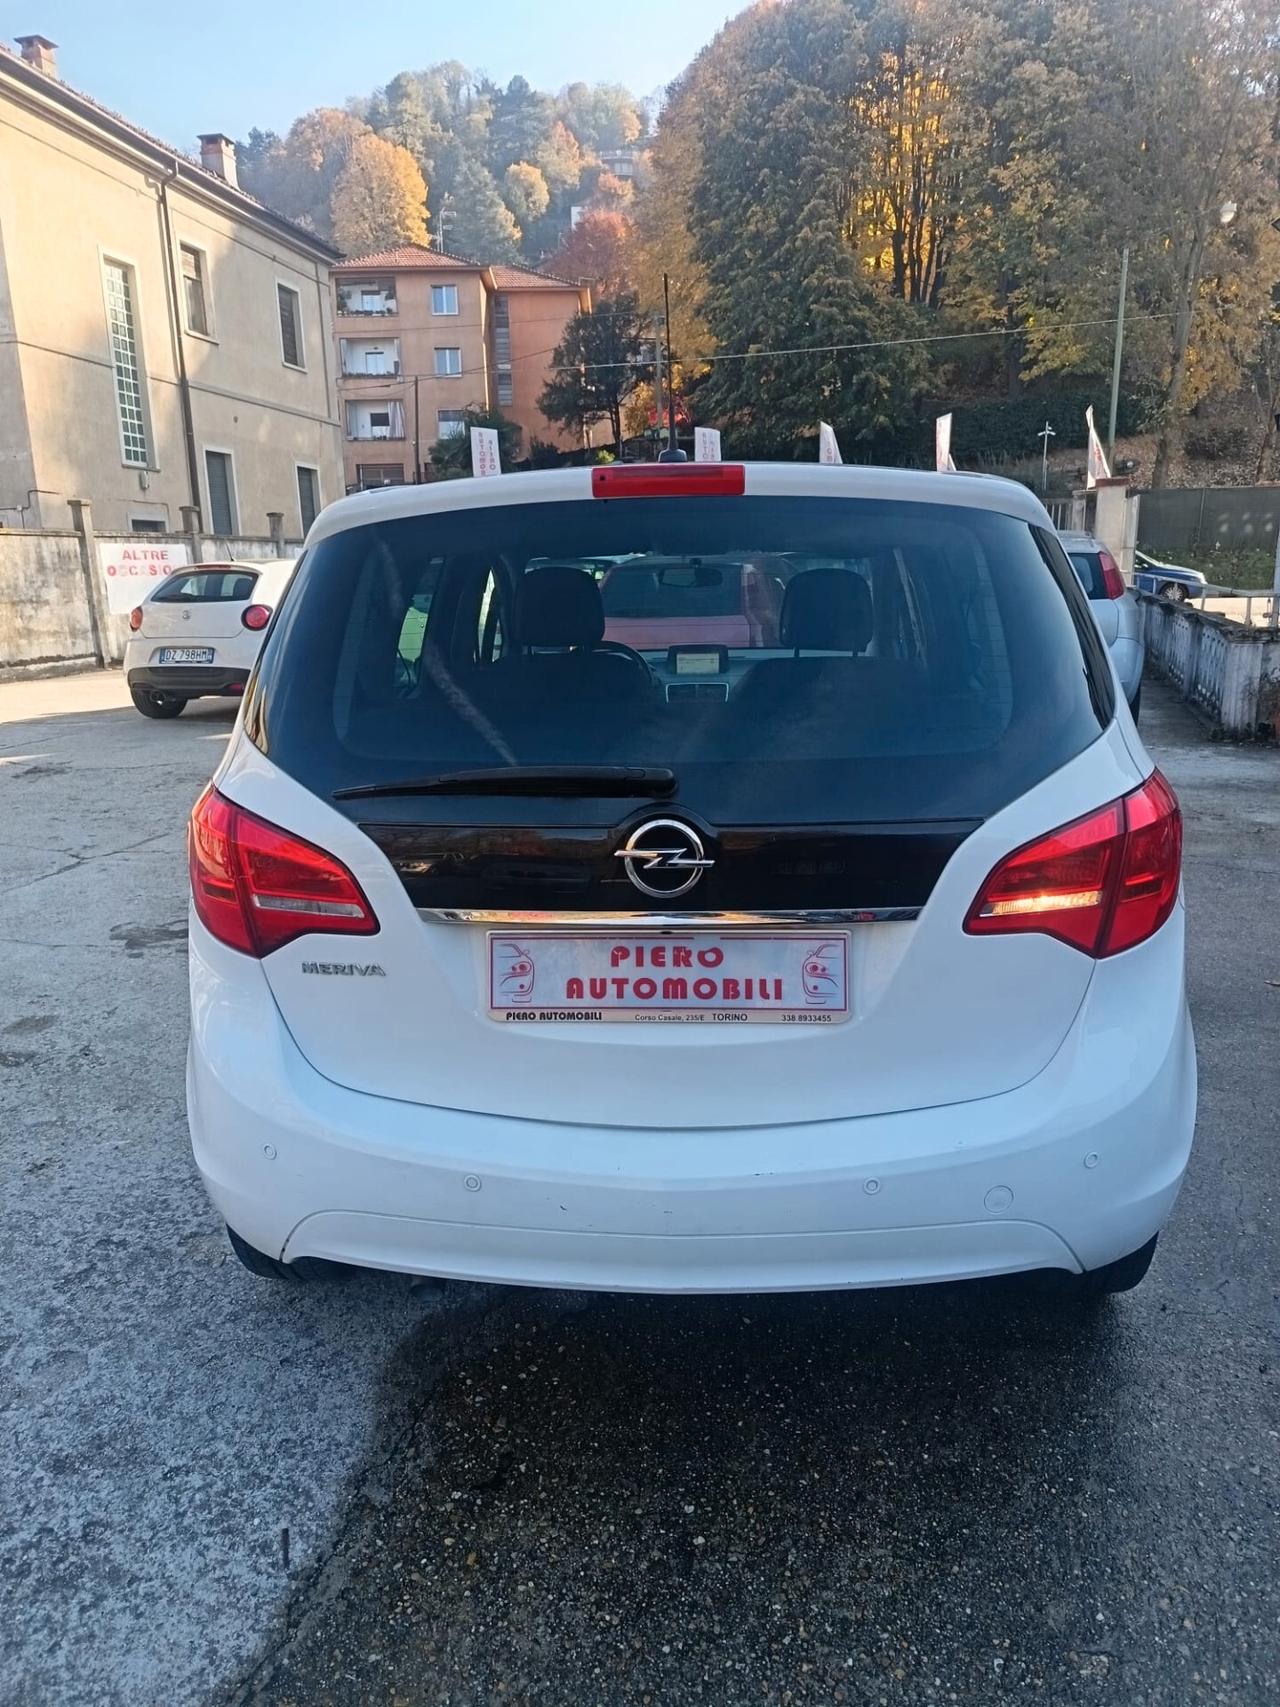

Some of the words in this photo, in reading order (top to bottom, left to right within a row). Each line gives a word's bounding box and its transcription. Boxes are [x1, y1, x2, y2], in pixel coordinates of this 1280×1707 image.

[122, 550, 169, 561] ALTRE
[610, 946, 725, 968] PIERO
[301, 962, 386, 977] MERIVA
[566, 978, 783, 1001] AUTOMOBILI
[506, 1012, 536, 1021] PIERO
[539, 1012, 602, 1021] AUTOMOBILI
[712, 1013, 748, 1022] TORINO
